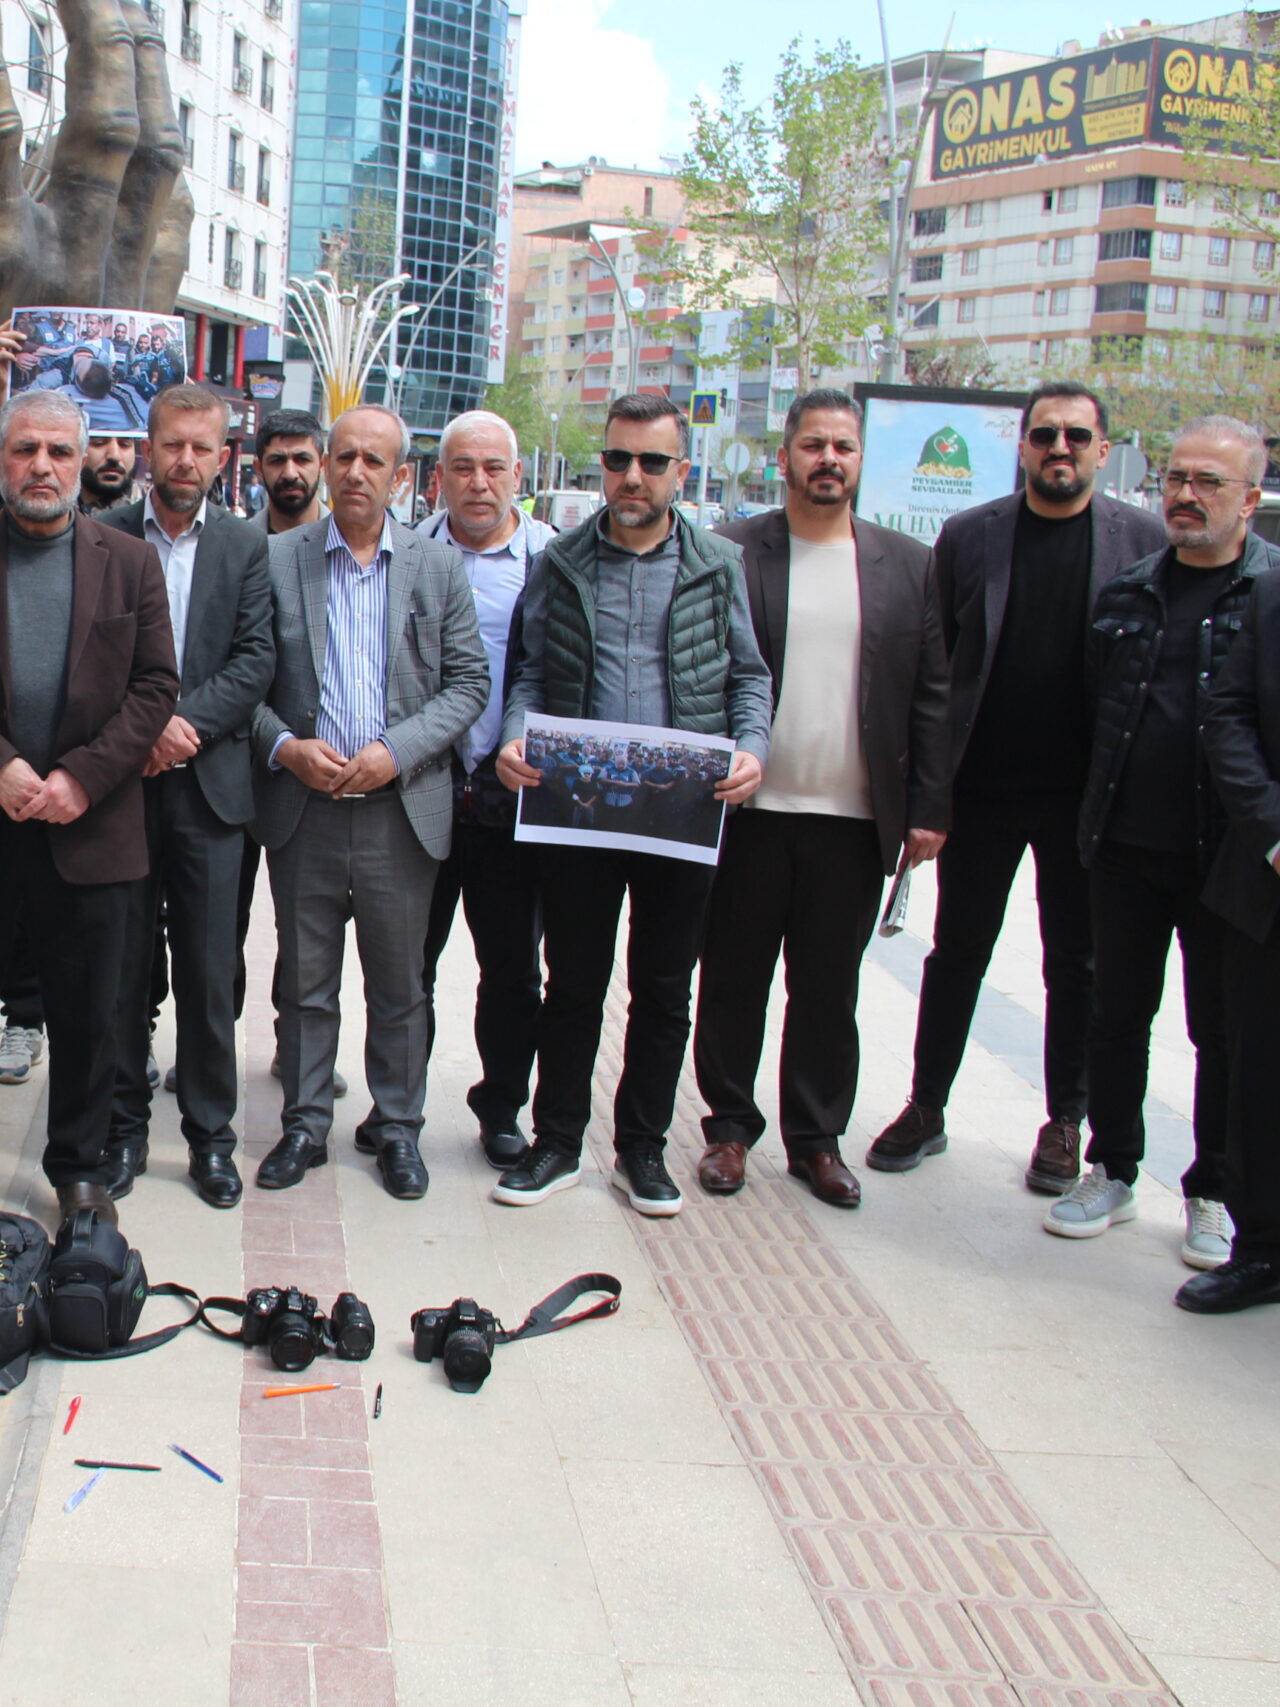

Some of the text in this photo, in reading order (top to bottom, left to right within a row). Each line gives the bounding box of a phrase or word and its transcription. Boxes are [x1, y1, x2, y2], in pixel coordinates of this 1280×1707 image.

[943, 66, 1078, 144] ONAS
[939, 126, 1072, 173] GAYRİMENKUL
[489, 38, 517, 361] YILMAZLAR CENTER
[912, 477, 972, 487] PEYGAMBER
